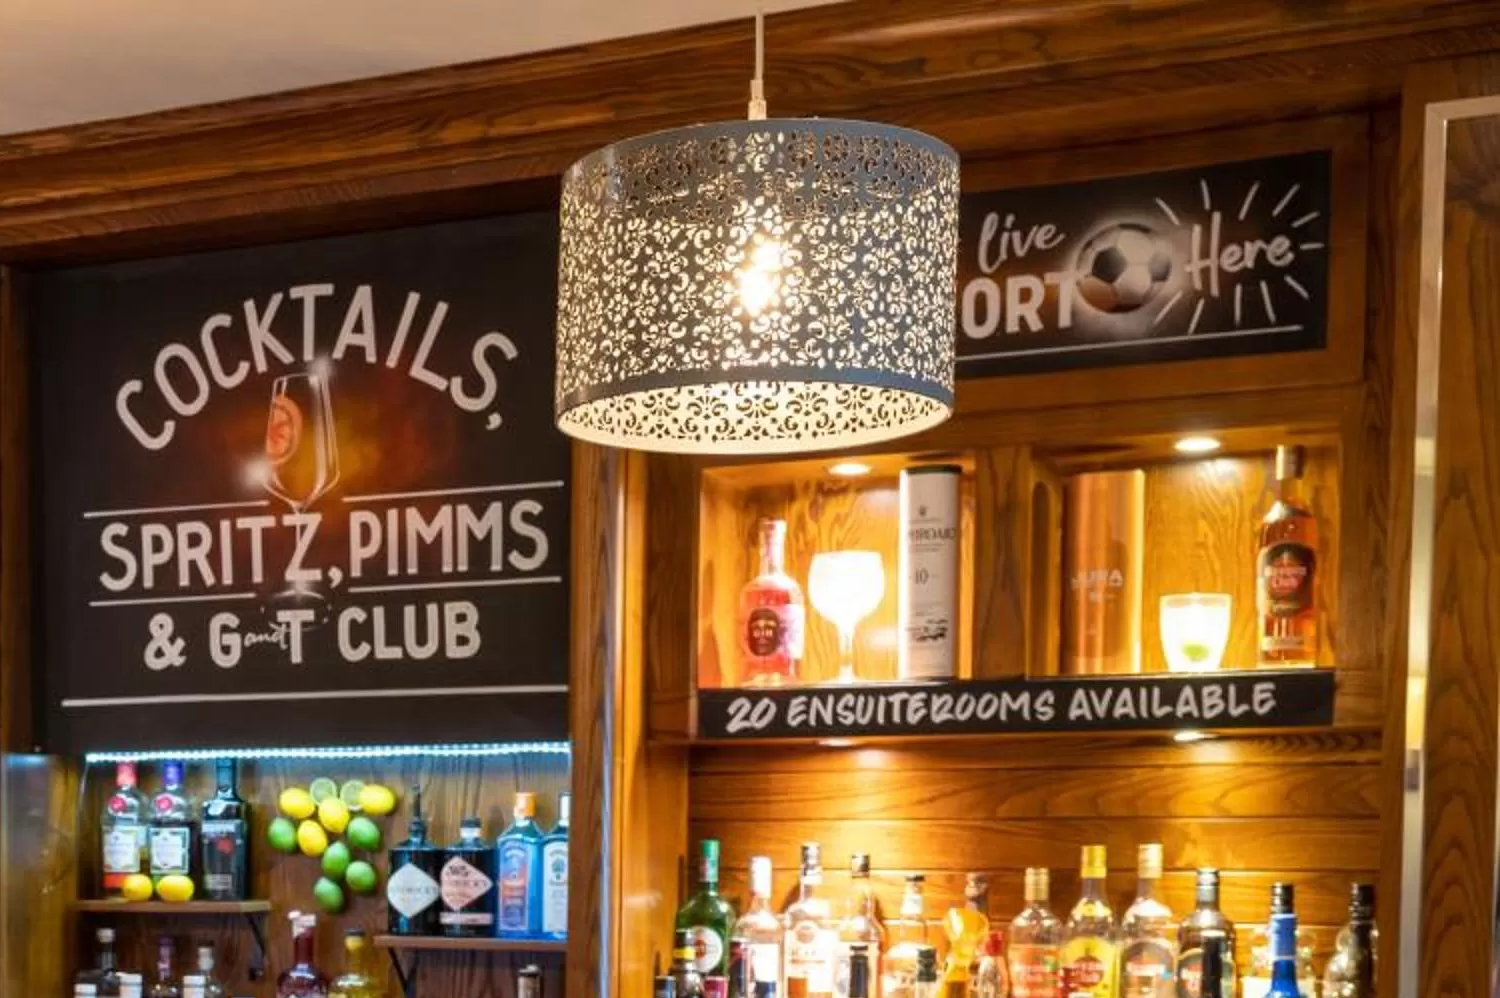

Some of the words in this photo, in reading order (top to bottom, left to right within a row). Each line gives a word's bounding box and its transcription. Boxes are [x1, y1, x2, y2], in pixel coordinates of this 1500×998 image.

[1184, 210, 1295, 297] Here
[348, 500, 550, 578] PIMMS
[337, 601, 482, 663] CLUB
[725, 697, 777, 734] 20
[1067, 682, 1277, 722] AVAILABLE
